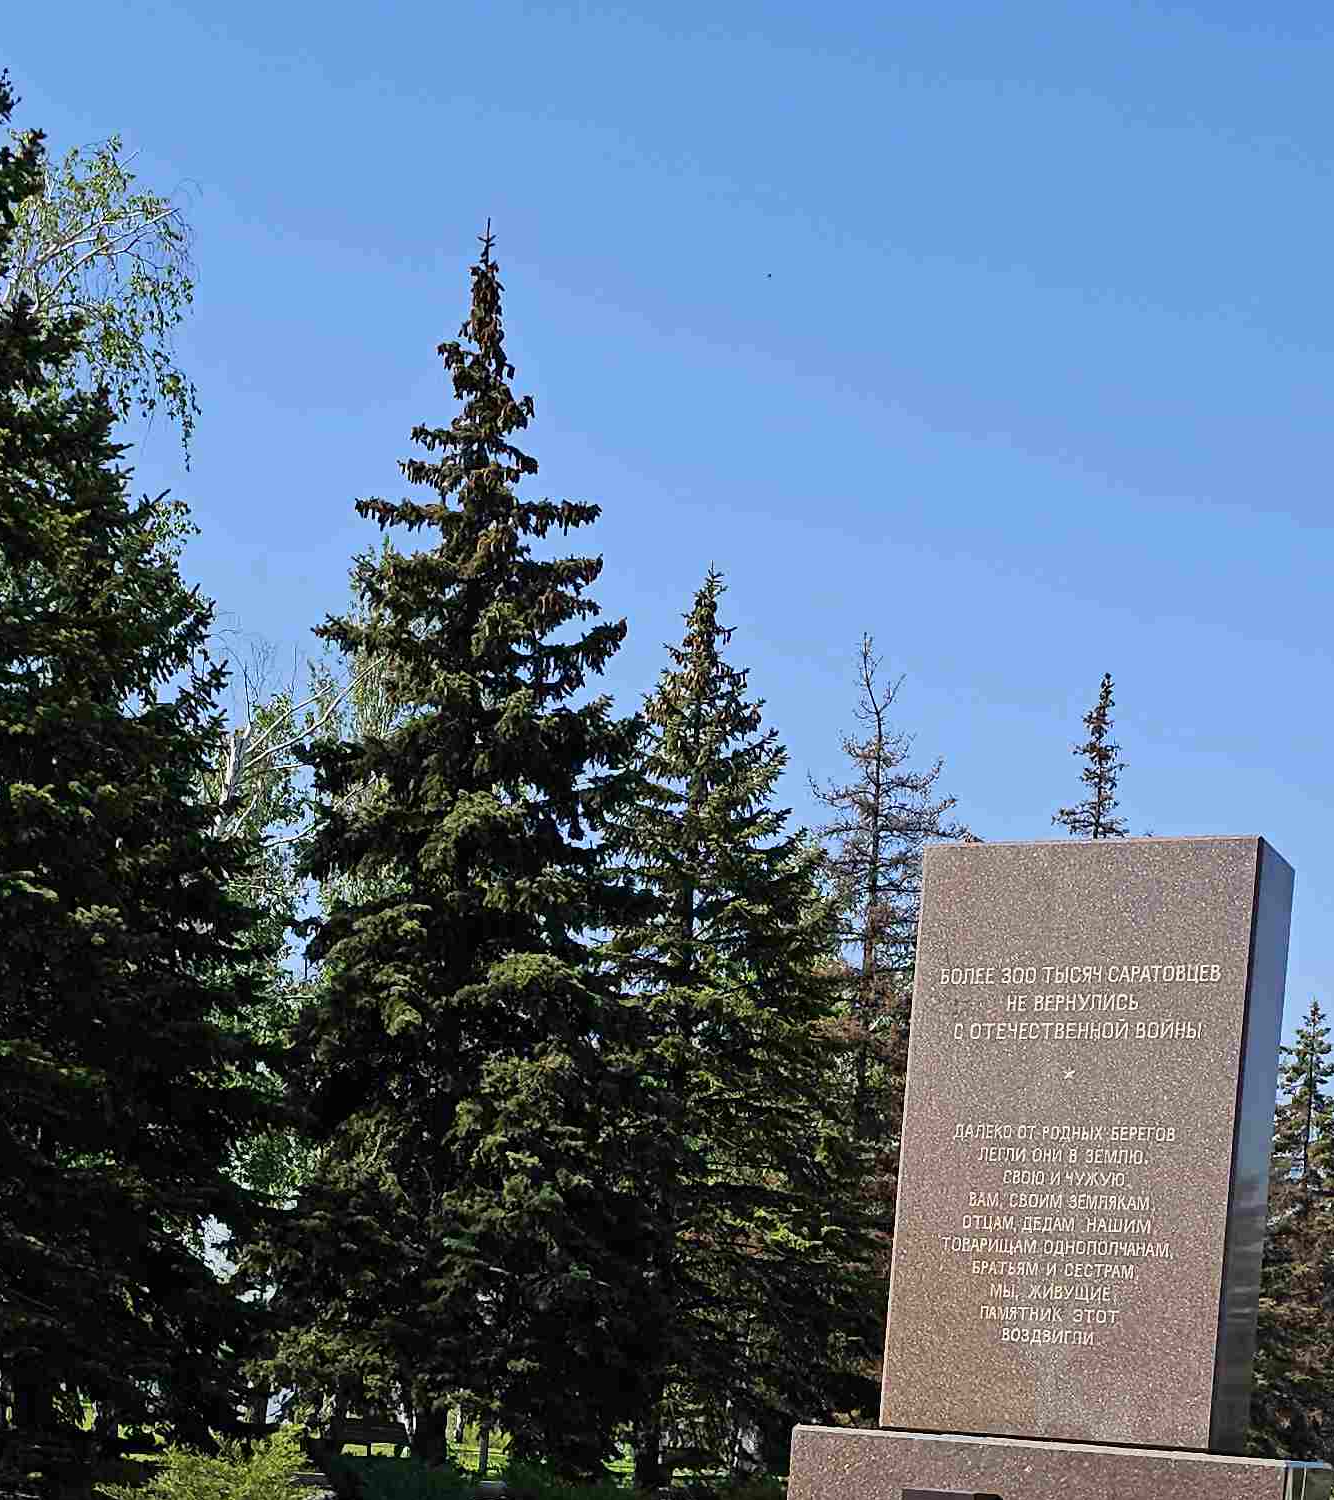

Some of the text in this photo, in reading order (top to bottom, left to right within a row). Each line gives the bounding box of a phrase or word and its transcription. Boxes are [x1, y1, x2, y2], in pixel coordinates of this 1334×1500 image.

[940, 964, 1221, 985] БОЛЕЕ 300 ТЫСЯЧ САРАТОВЦЕВ
[1006, 993, 1139, 1012] НЕ ВЕРНУЛИСЬ
[954, 1017, 1202, 1040] С ОТЕЧЕСТВЕННОЙ ВОЙНЫ
[953, 1124, 1176, 1142] ДАЛЕКО ОТ РОДНЫХ БЕРЕГОВ
[978, 1147, 1027, 1162] ЛЕГЛИ
[1033, 1148, 1062, 1162] ОНИ
[1069, 1149, 1077, 1163] В
[1003, 1170, 1045, 1185] СВОЮ
[1050, 1171, 1061, 1185] И
[1009, 1193, 1062, 1208] СВОИМ
[972, 1260, 1039, 1276] БРАТЬЯМ
[1046, 1263, 1057, 1276] И
[980, 1306, 1119, 1324] ПАМЯТНИК ЭТОТ
